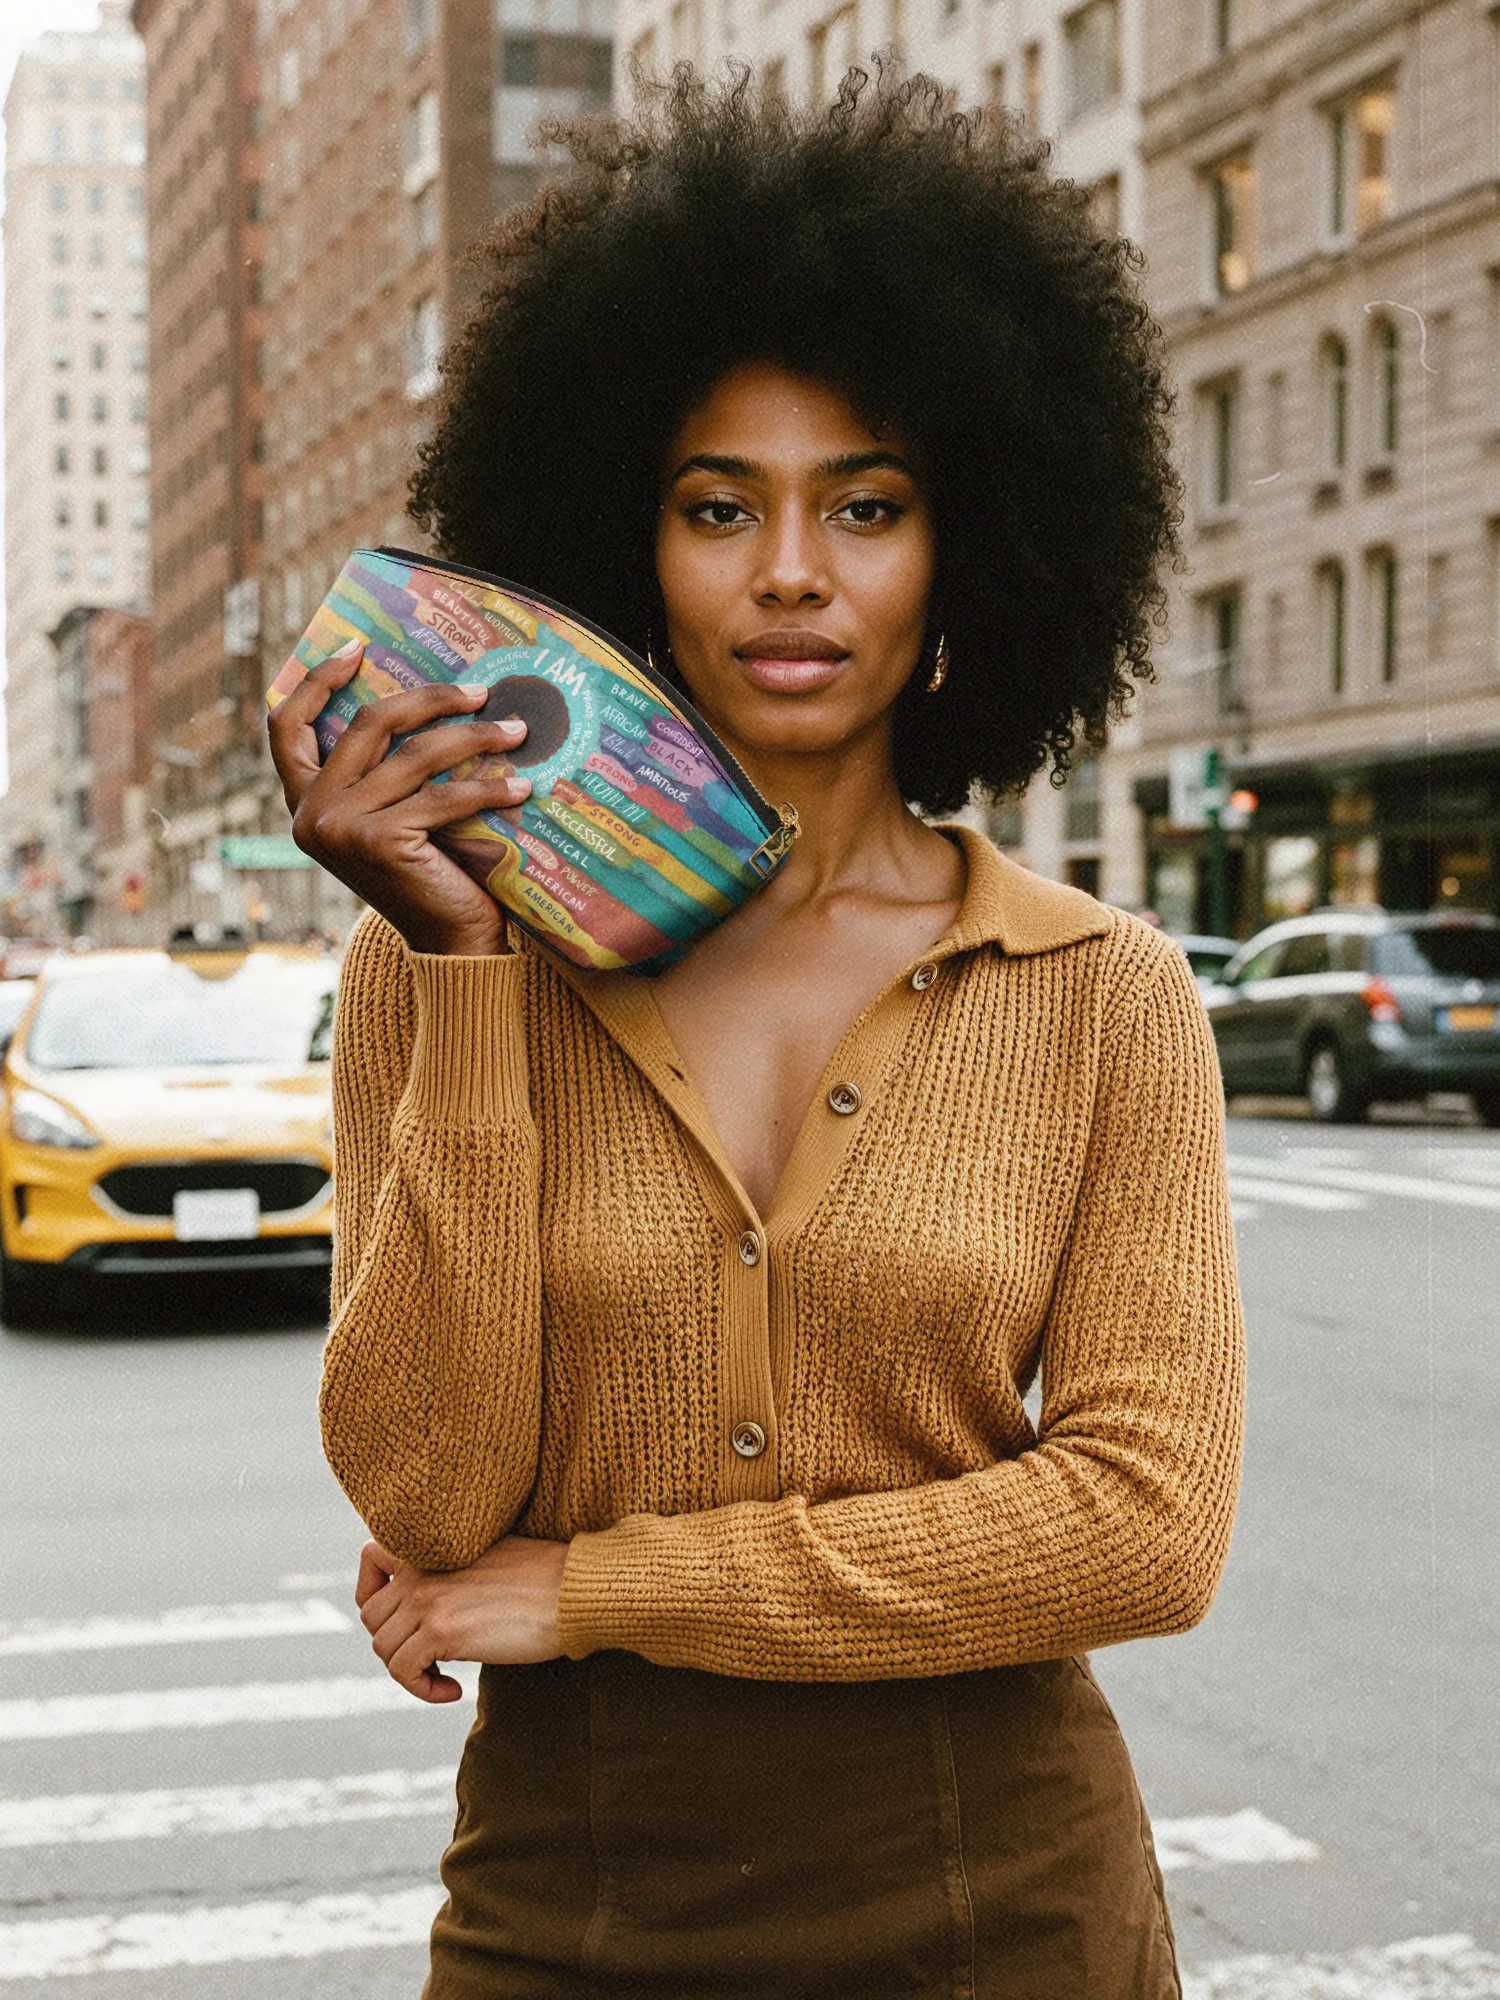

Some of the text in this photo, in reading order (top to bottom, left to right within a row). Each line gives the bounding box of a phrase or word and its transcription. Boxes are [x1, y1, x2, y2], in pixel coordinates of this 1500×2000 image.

[427, 612, 477, 652] STRONG
[433, 590, 489, 646] BEAUTIFUL
[484, 611, 524, 645] woman
[495, 598, 532, 629] BRAVE
[392, 640, 440, 680] BEAUTIFUL
[410, 627, 464, 666] AFRICAN
[486, 650, 530, 671] BEAUTIFUL
[533, 648, 587, 697] I AM
[581, 690, 594, 719] PROUD
[610, 683, 649, 712] BRAVE
[600, 704, 648, 739] AFRICAN
[656, 722, 704, 758] CONFIDENT
[589, 757, 636, 788] STRONG
[649, 741, 694, 777] BLACK
[635, 765, 691, 803] AMBITIOUS
[533, 820, 589, 869] MAGICAL
[546, 801, 617, 862] SUCCESSFUL
[589, 808, 641, 847] STRONG
[525, 865, 587, 911] AMERICAN
[560, 866, 599, 897] POWER
[524, 887, 574, 934] AMERICAN
